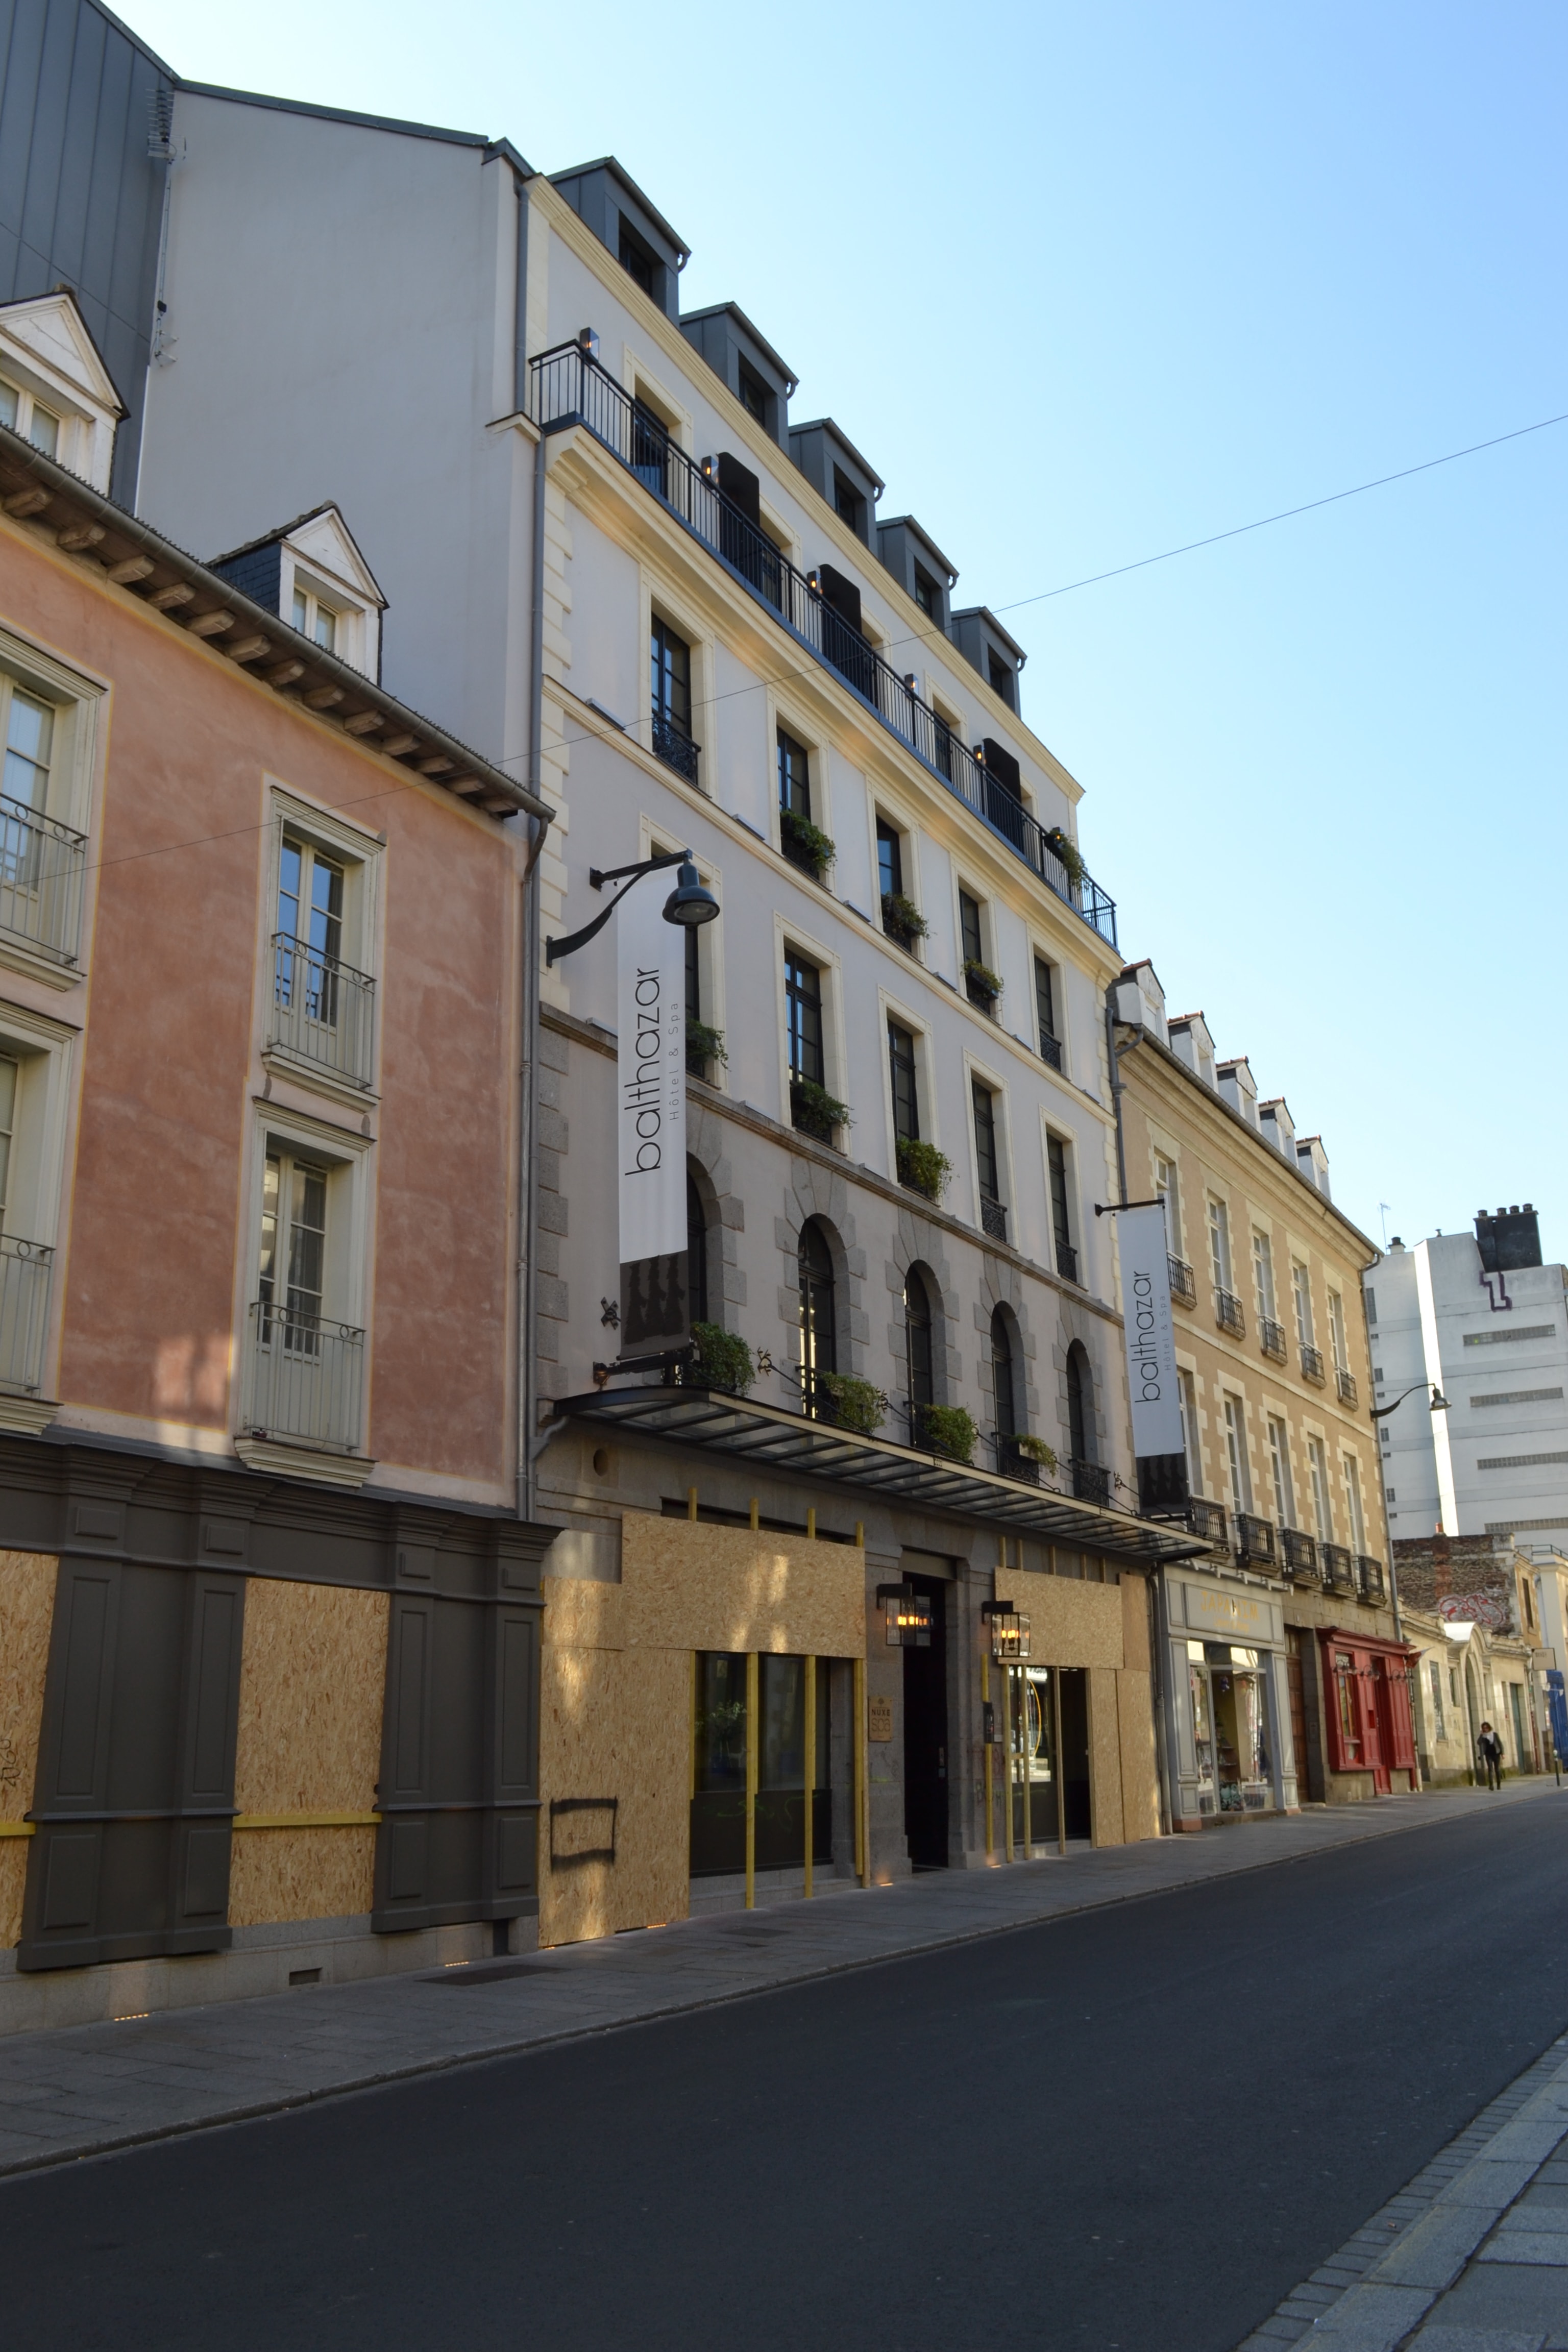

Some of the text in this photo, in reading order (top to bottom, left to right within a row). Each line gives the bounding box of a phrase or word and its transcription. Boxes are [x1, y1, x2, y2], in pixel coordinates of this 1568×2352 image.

[624, 968, 662, 1176] balthazar
[668, 1003, 681, 1121] Hôtel & Spa
[1130, 1271, 1161, 1403] balthazar
[1159, 1295, 1168, 1316] Spa
[1161, 1338, 1172, 1371] Hôtel
